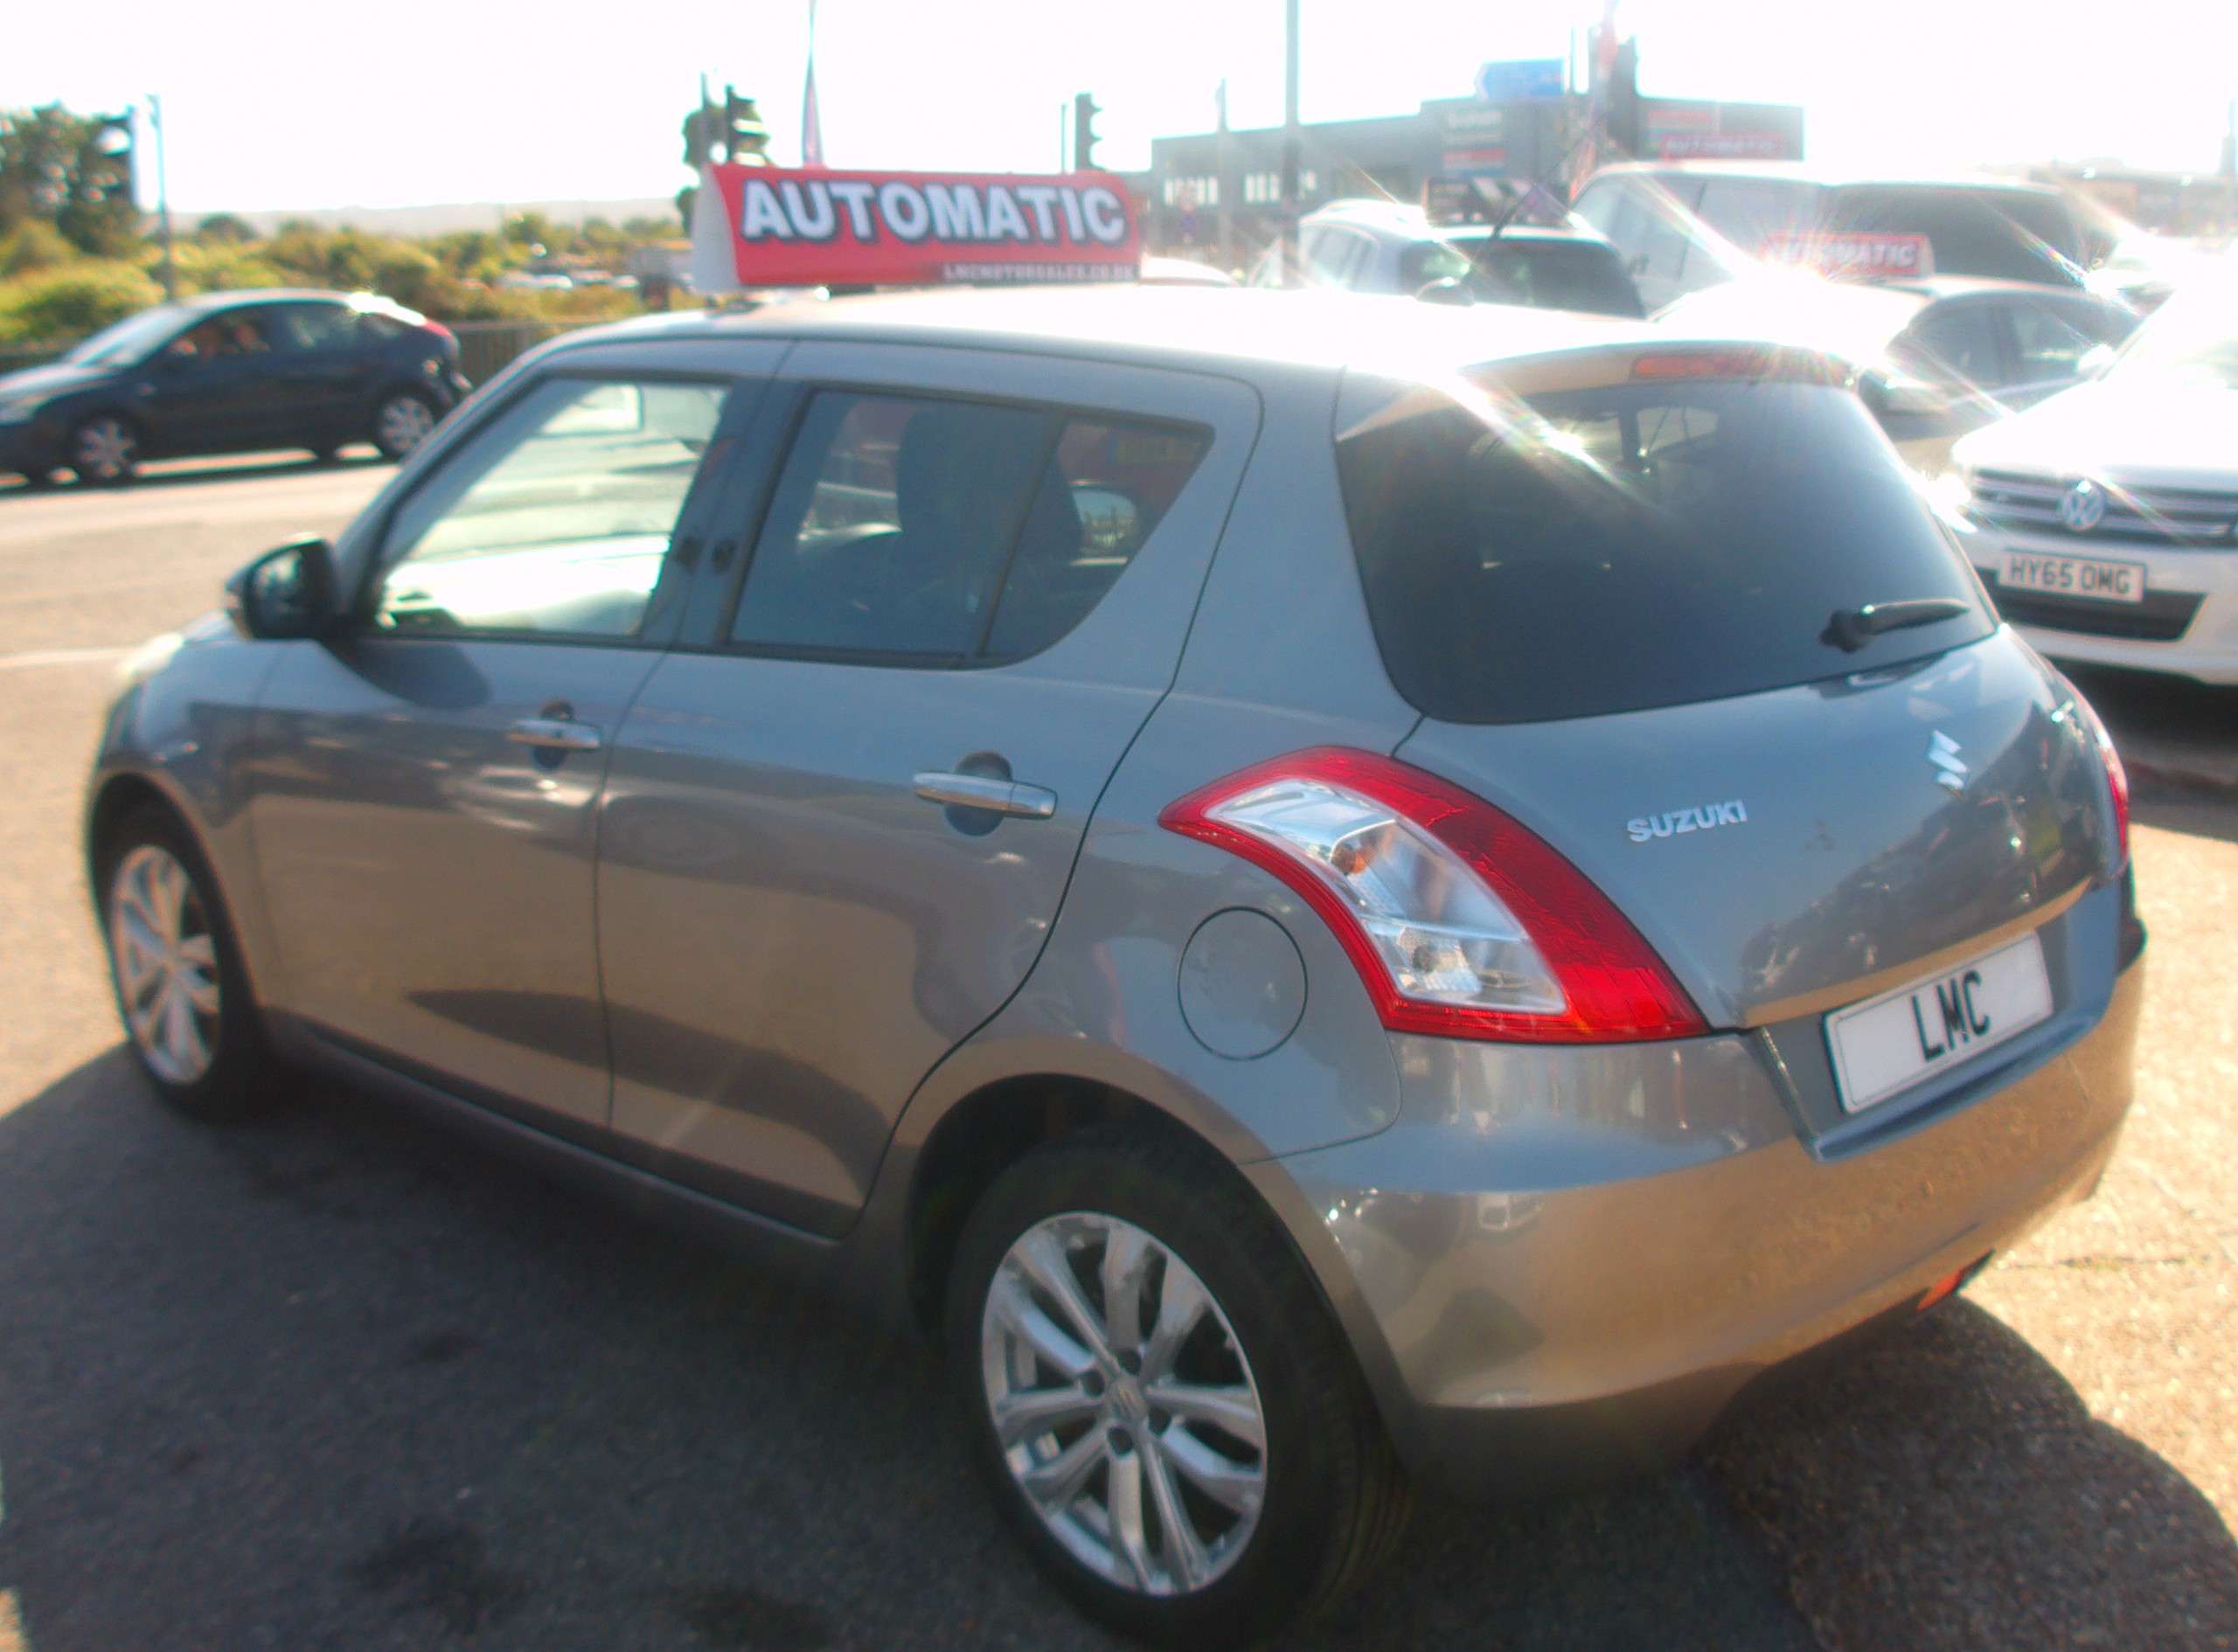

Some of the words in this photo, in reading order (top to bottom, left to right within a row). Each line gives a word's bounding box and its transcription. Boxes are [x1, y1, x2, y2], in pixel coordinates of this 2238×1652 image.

[741, 177, 1127, 243] AUTOMATIC
[2010, 557, 2074, 588] HY65
[2081, 563, 2131, 594] OMG
[1626, 799, 1748, 843] SUZUKI
[1911, 969, 1991, 1062] LMC
